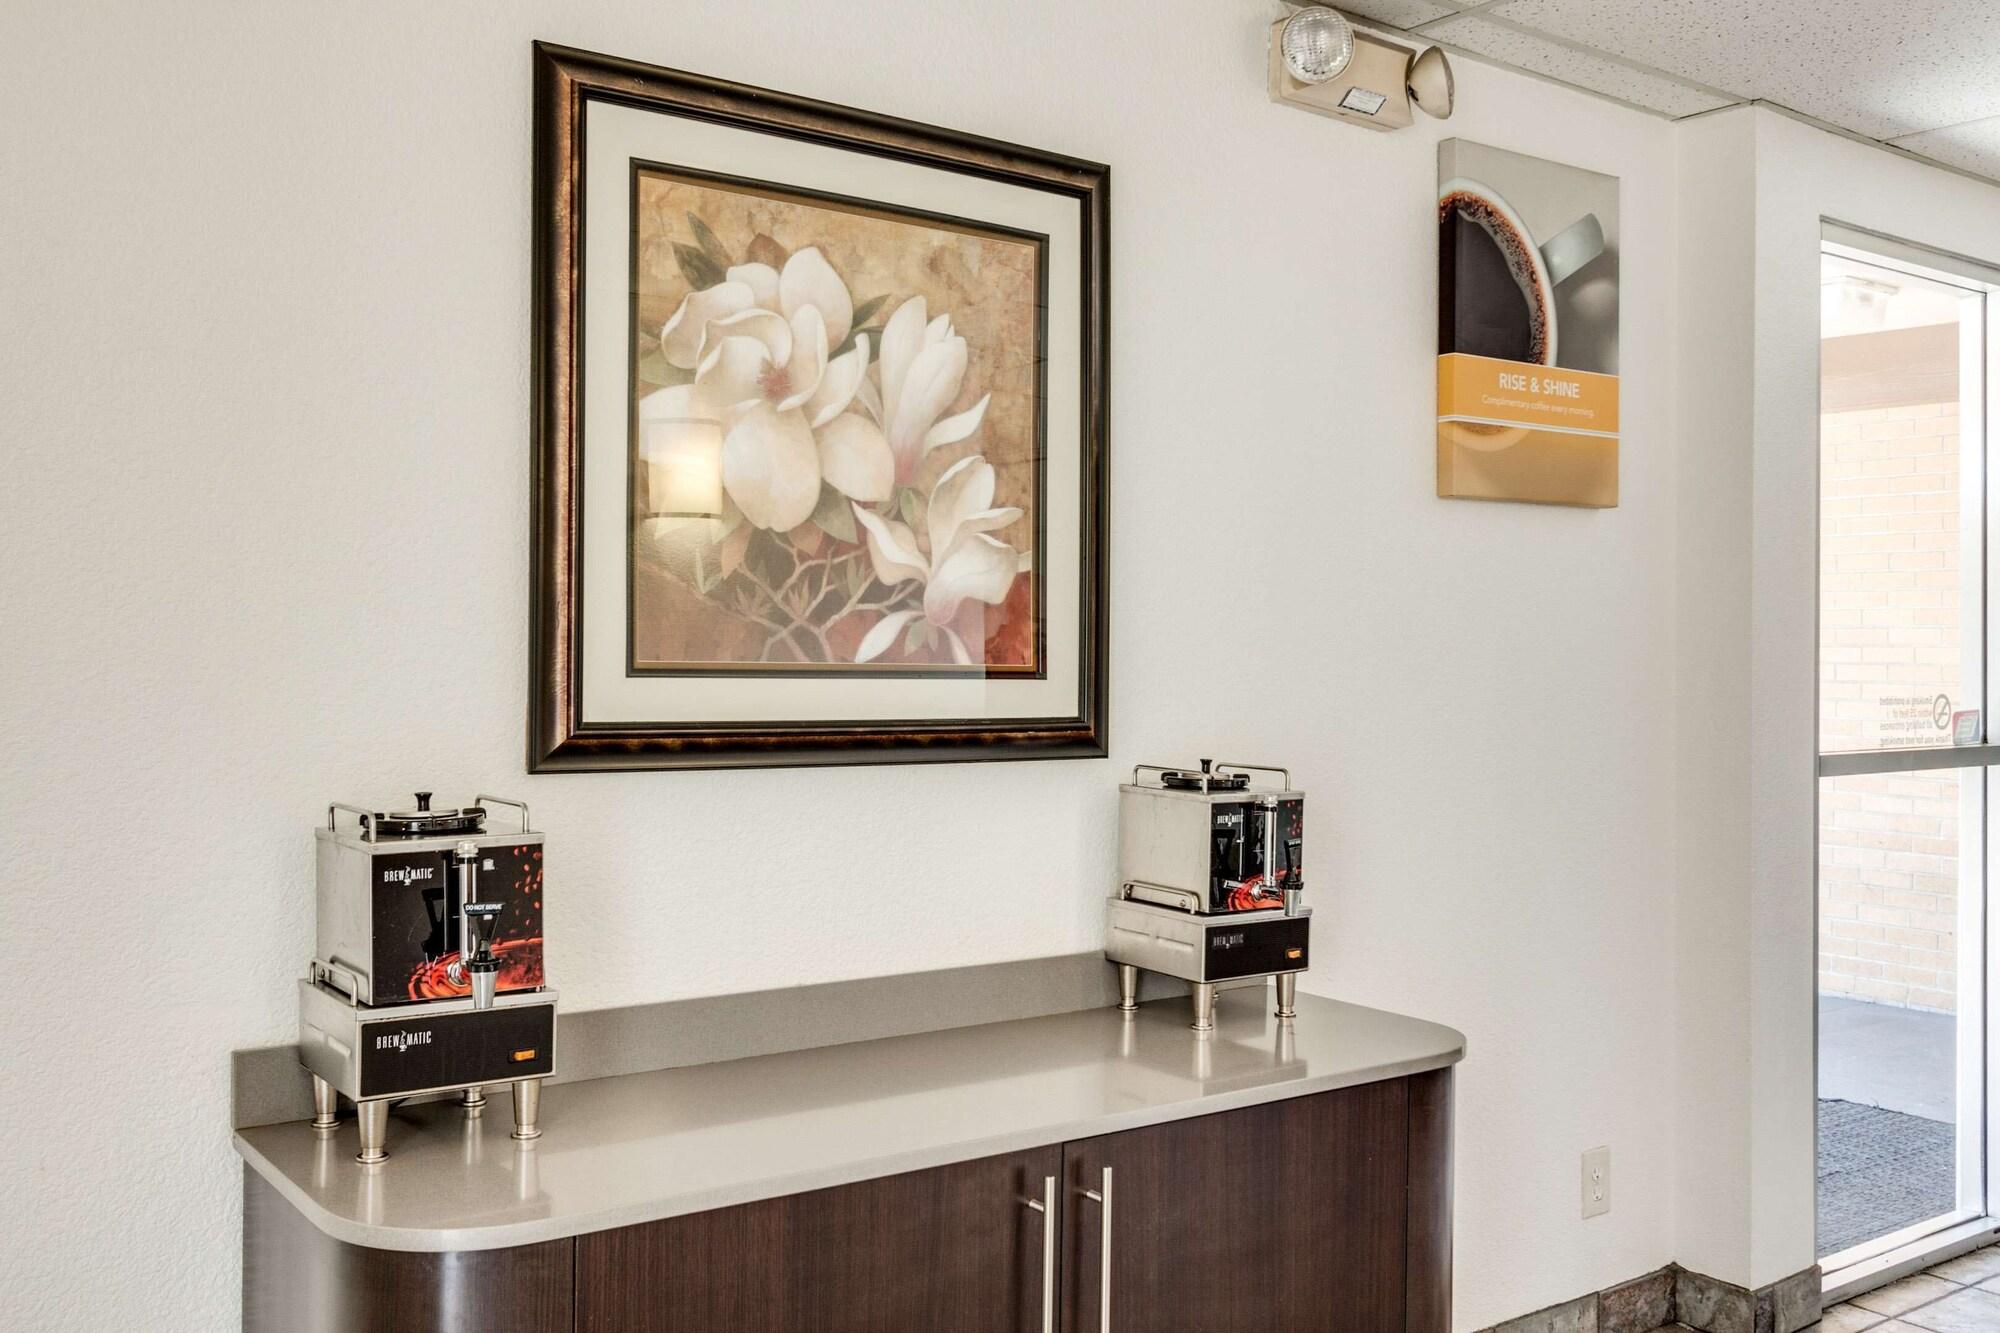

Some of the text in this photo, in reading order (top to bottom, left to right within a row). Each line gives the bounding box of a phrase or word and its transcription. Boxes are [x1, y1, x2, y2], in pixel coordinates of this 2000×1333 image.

[1499, 372, 1581, 399] RISE & SHINE
[1481, 394, 1529, 411] Complimentary
[1530, 400, 1550, 412] coffee
[1551, 405, 1568, 416] every
